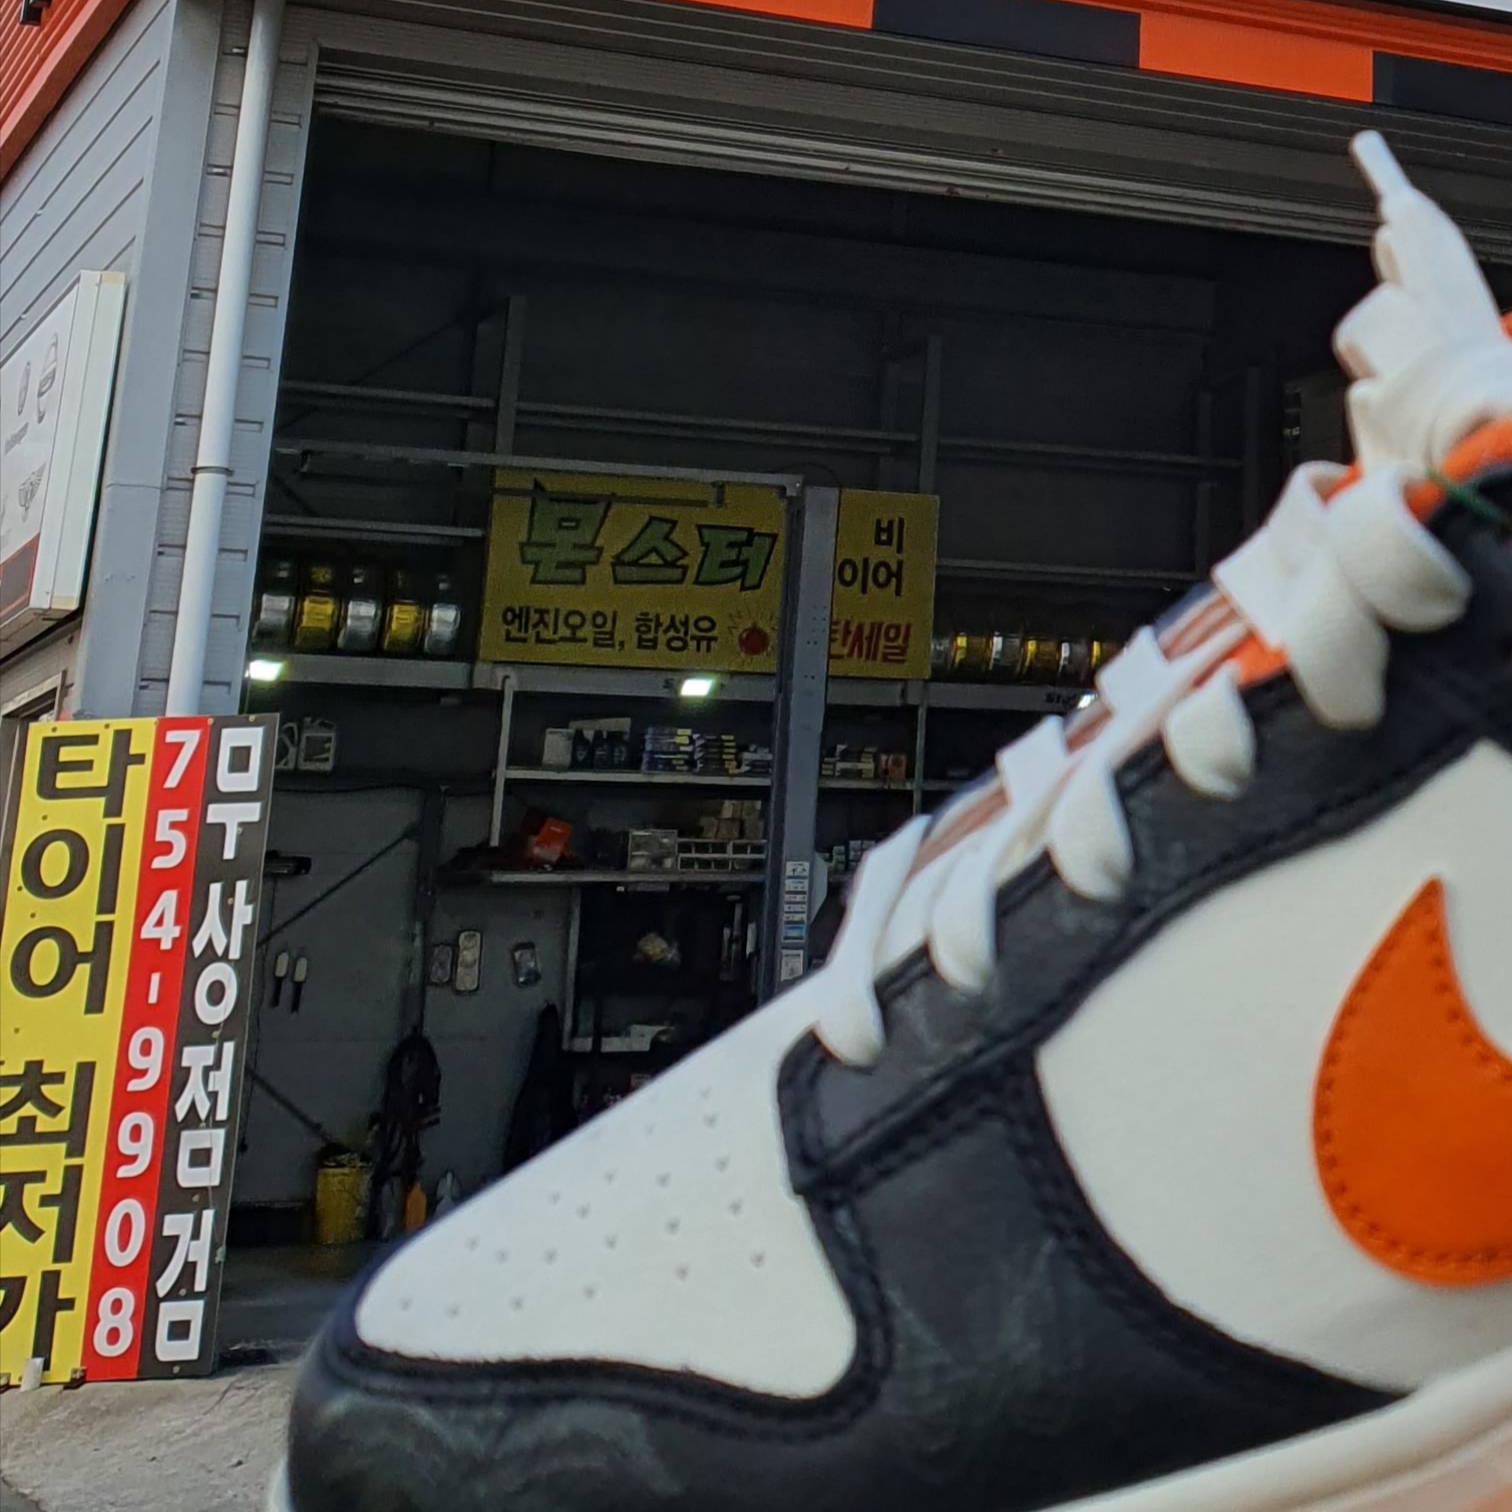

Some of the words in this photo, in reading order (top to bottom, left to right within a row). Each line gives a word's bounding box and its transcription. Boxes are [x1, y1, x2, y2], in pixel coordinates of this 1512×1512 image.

[519, 480, 778, 592] 몬스터
[837, 558, 903, 597] 이어
[635, 612, 719, 654] 합성유
[829, 620, 911, 663] 탄세일
[10, 729, 145, 1016] 타이어
[92, 729, 201, 1358] 754-9908
[155, 726, 265, 1363] 무상점검
